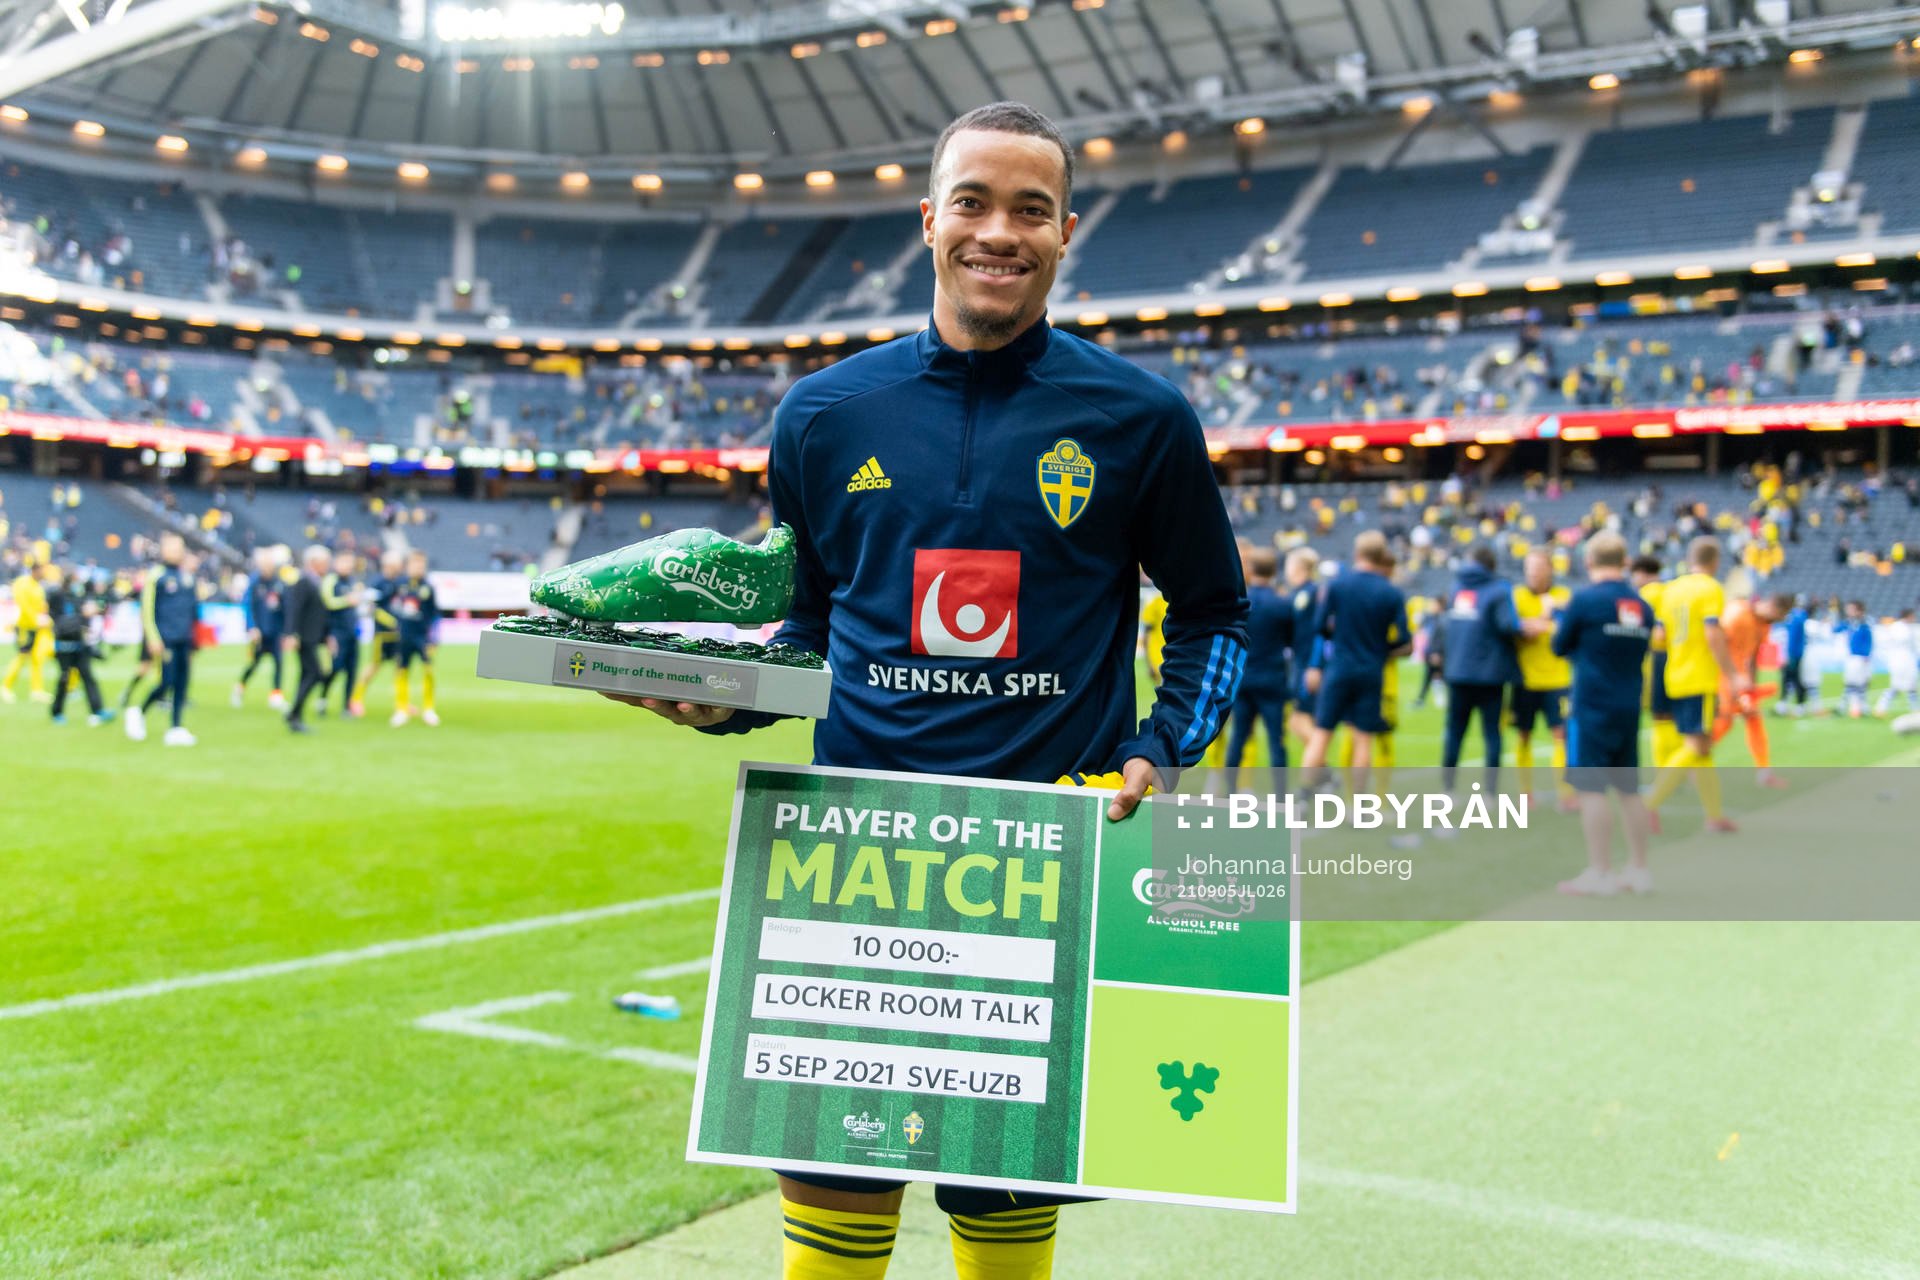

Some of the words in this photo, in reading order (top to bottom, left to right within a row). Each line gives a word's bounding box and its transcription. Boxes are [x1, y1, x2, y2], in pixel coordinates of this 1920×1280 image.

[1047, 463, 1087, 474] SVERIGE
[847, 476, 892, 493] adidas
[653, 550, 760, 611] Carlsberg
[592, 661, 630, 676] Player
[631, 666, 645, 677] of
[646, 668, 665, 680] the
[666, 673, 702, 684] match
[706, 674, 742, 691] Carlsberg
[867, 663, 994, 696] SVENSKA
[1003, 672, 1067, 697] SPEL
[774, 802, 917, 840] PLAYER
[929, 814, 981, 844] OF
[992, 818, 1064, 851] THE
[766, 838, 1062, 923] MATCH
[767, 921, 802, 934] Belopp
[1147, 915, 1206, 929] ALCOHOL
[1209, 920, 1240, 932] FREE
[853, 935, 881, 957] 10
[889, 938, 959, 964] 000:-
[765, 982, 871, 1012] LOCKER
[879, 991, 962, 1019] ROOM
[971, 999, 1041, 1026] TALK
[753, 1039, 787, 1050] Datum
[755, 1052, 771, 1074] 5
[778, 1054, 827, 1079] SEP
[833, 1059, 895, 1085] 2021
[907, 1066, 1022, 1097] SVE-UZB
[843, 1114, 886, 1134] Carlsberg
